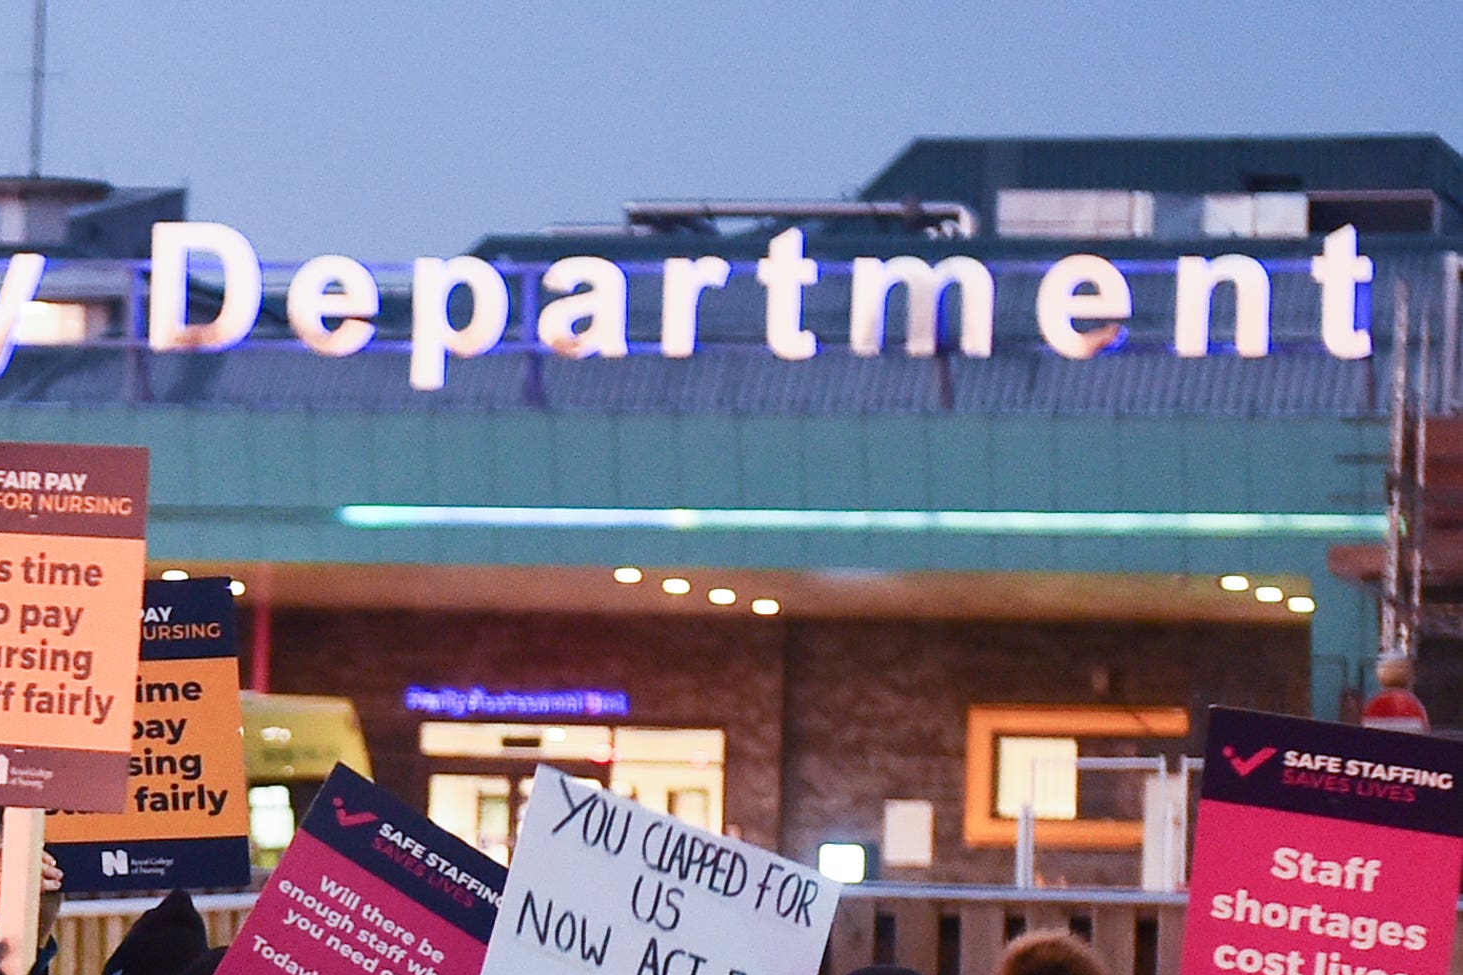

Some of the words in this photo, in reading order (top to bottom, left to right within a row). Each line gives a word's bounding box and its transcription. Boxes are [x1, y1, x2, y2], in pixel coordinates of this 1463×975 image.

[147, 219, 1376, 392] Department
[44, 472, 87, 492] PAY
[38, 494, 133, 515] NURSING
[22, 552, 104, 588] time
[20, 605, 85, 637] pay
[143, 622, 222, 640] URSING
[23, 683, 114, 726] fairly
[135, 675, 202, 703] ime
[1282, 770, 1351, 791] SAVES
[1355, 782, 1417, 803] LIVES
[1283, 751, 1341, 775] SAFE
[1344, 759, 1454, 790] STAFFING
[134, 784, 228, 817] fairly
[377, 823, 424, 860] SAFE
[552, 775, 632, 856] YOU
[641, 821, 748, 898] CLAPPED
[754, 864, 819, 928] FOR
[1270, 846, 1382, 893] Staff
[278, 878, 356, 934] enough
[356, 927, 407, 963] staff
[318, 874, 361, 912] Will
[362, 904, 416, 945] there
[416, 936, 445, 964] be
[631, 875, 685, 931] US
[1210, 888, 1428, 951] shortages
[283, 907, 325, 941] you
[325, 932, 380, 974] need
[516, 889, 612, 967] NOW
